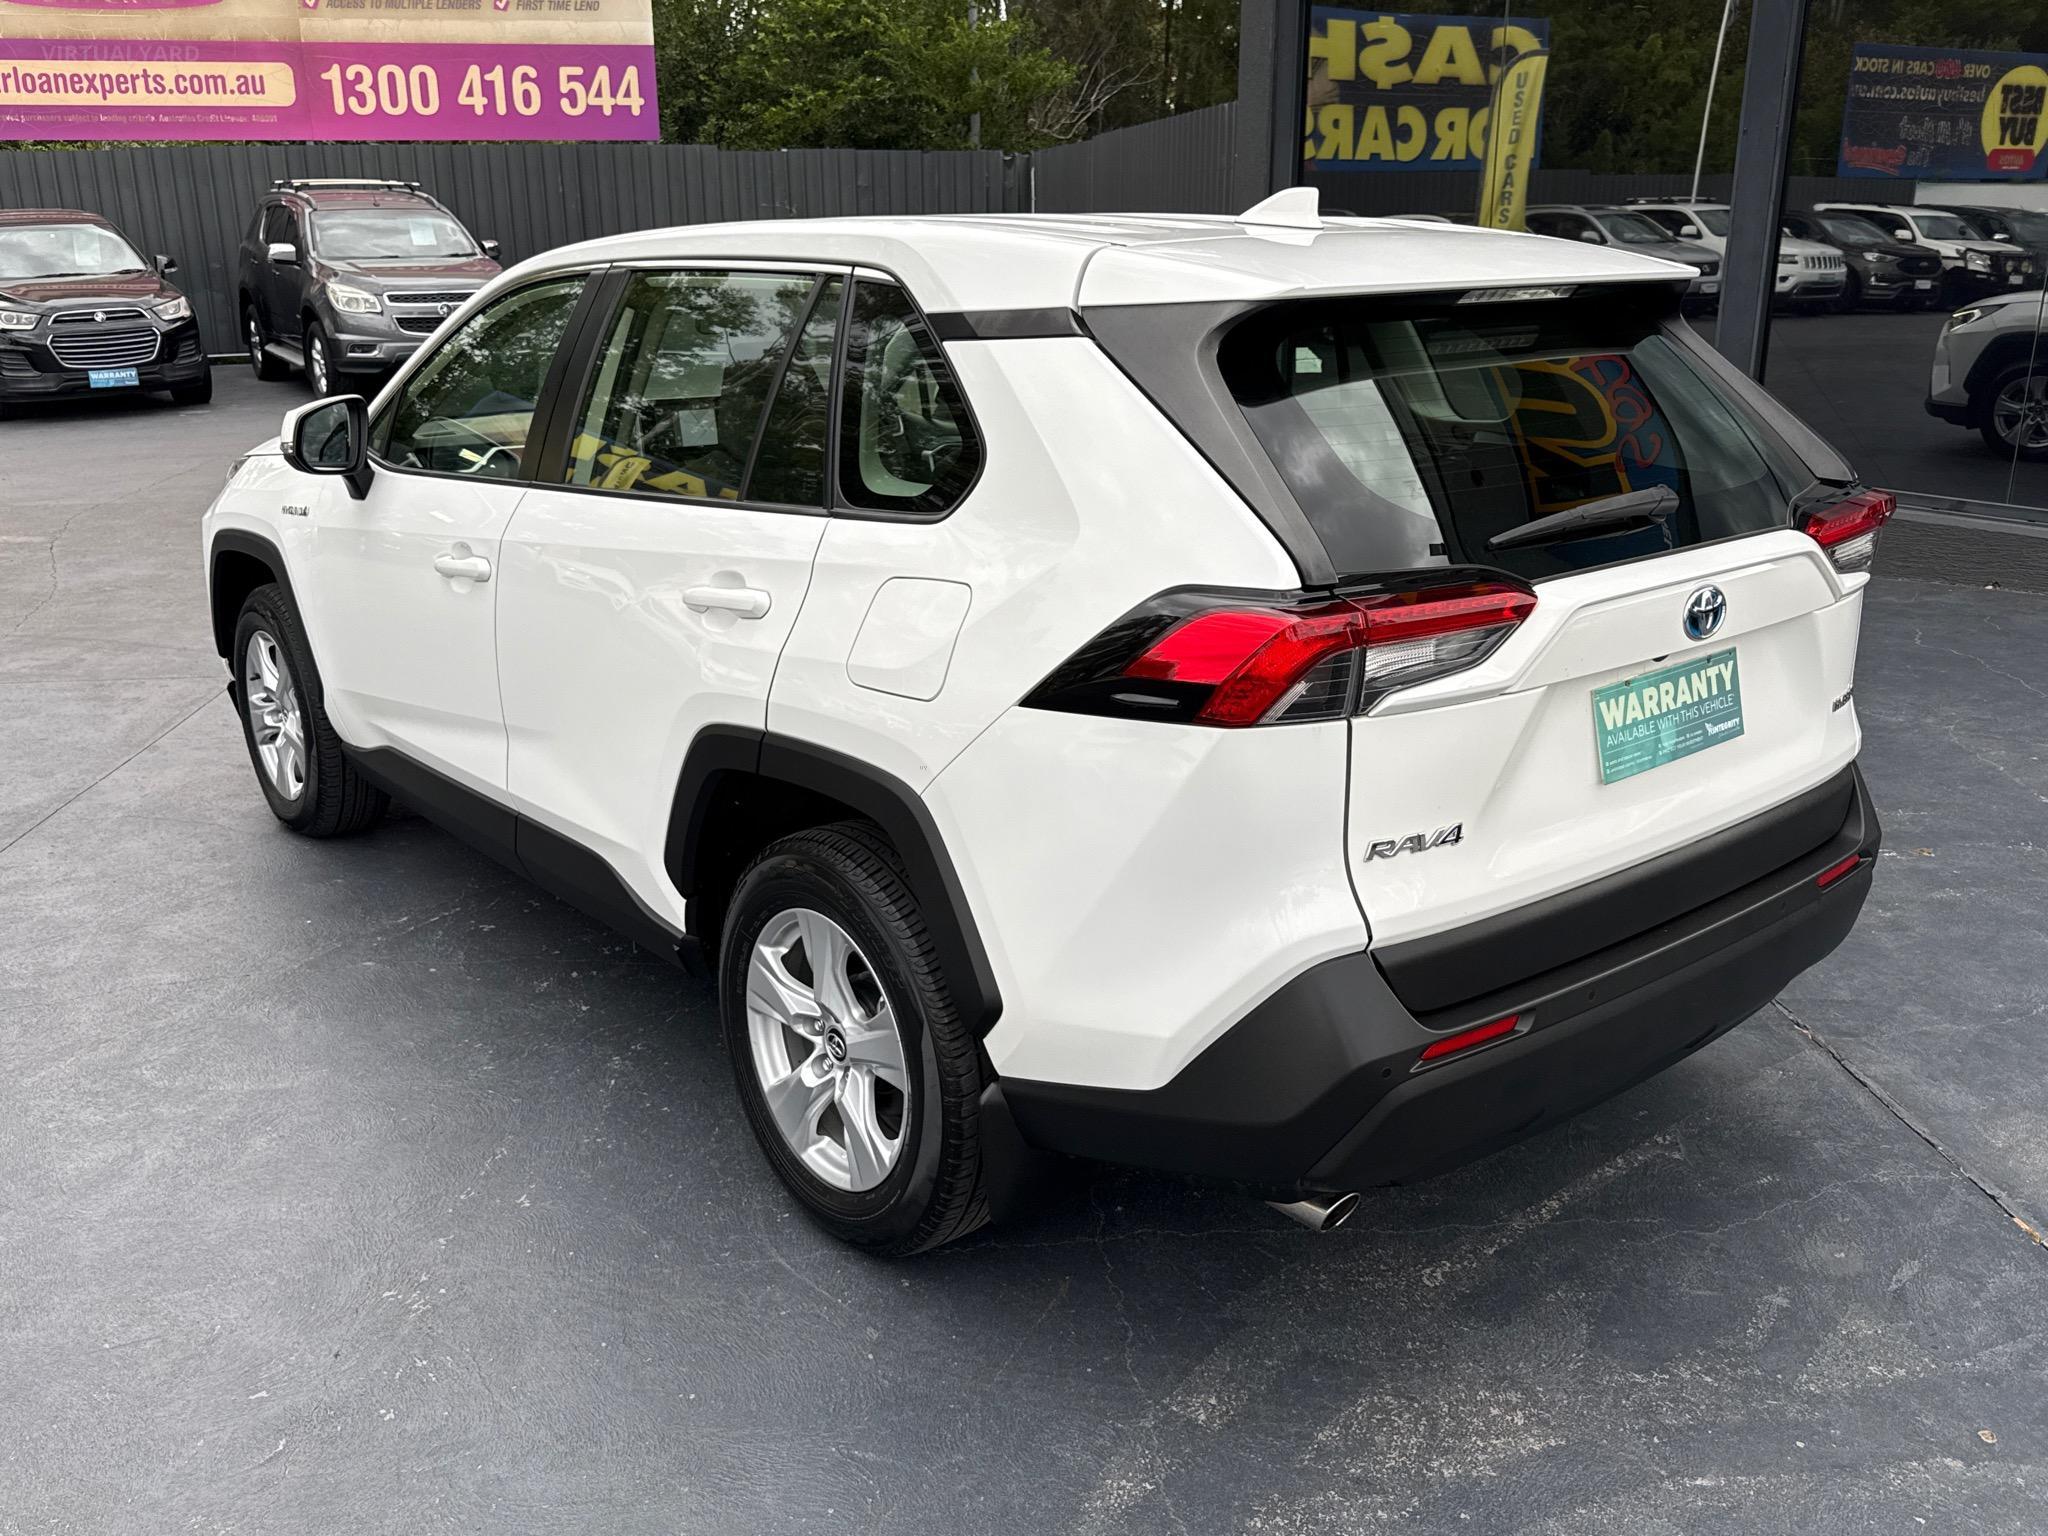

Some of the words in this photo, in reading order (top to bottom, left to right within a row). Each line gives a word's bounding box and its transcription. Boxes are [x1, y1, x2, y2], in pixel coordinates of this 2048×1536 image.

[325, 0, 368, 10] ACCESS
[369, 0, 381, 10] TO
[381, 0, 433, 10] MULTIPLE
[436, 0, 482, 10] LENDERS
[516, 0, 543, 11] FIRST
[547, 0, 572, 11] TIME
[0, 66, 265, 100] rloanexperts.com.au
[320, 63, 440, 116] 1300
[457, 64, 542, 116] 416
[559, 65, 645, 116] 544
[1508, 71, 1529, 145] USED
[1498, 153, 1518, 224] CARS
[1598, 660, 1734, 730] WARRANTY
[1606, 718, 1656, 748] AVAILABLE
[1656, 714, 1680, 730] WITH
[1680, 706, 1699, 722] THIS
[1699, 694, 1735, 715] VEHICLE
[1363, 822, 1463, 863] RAV4
